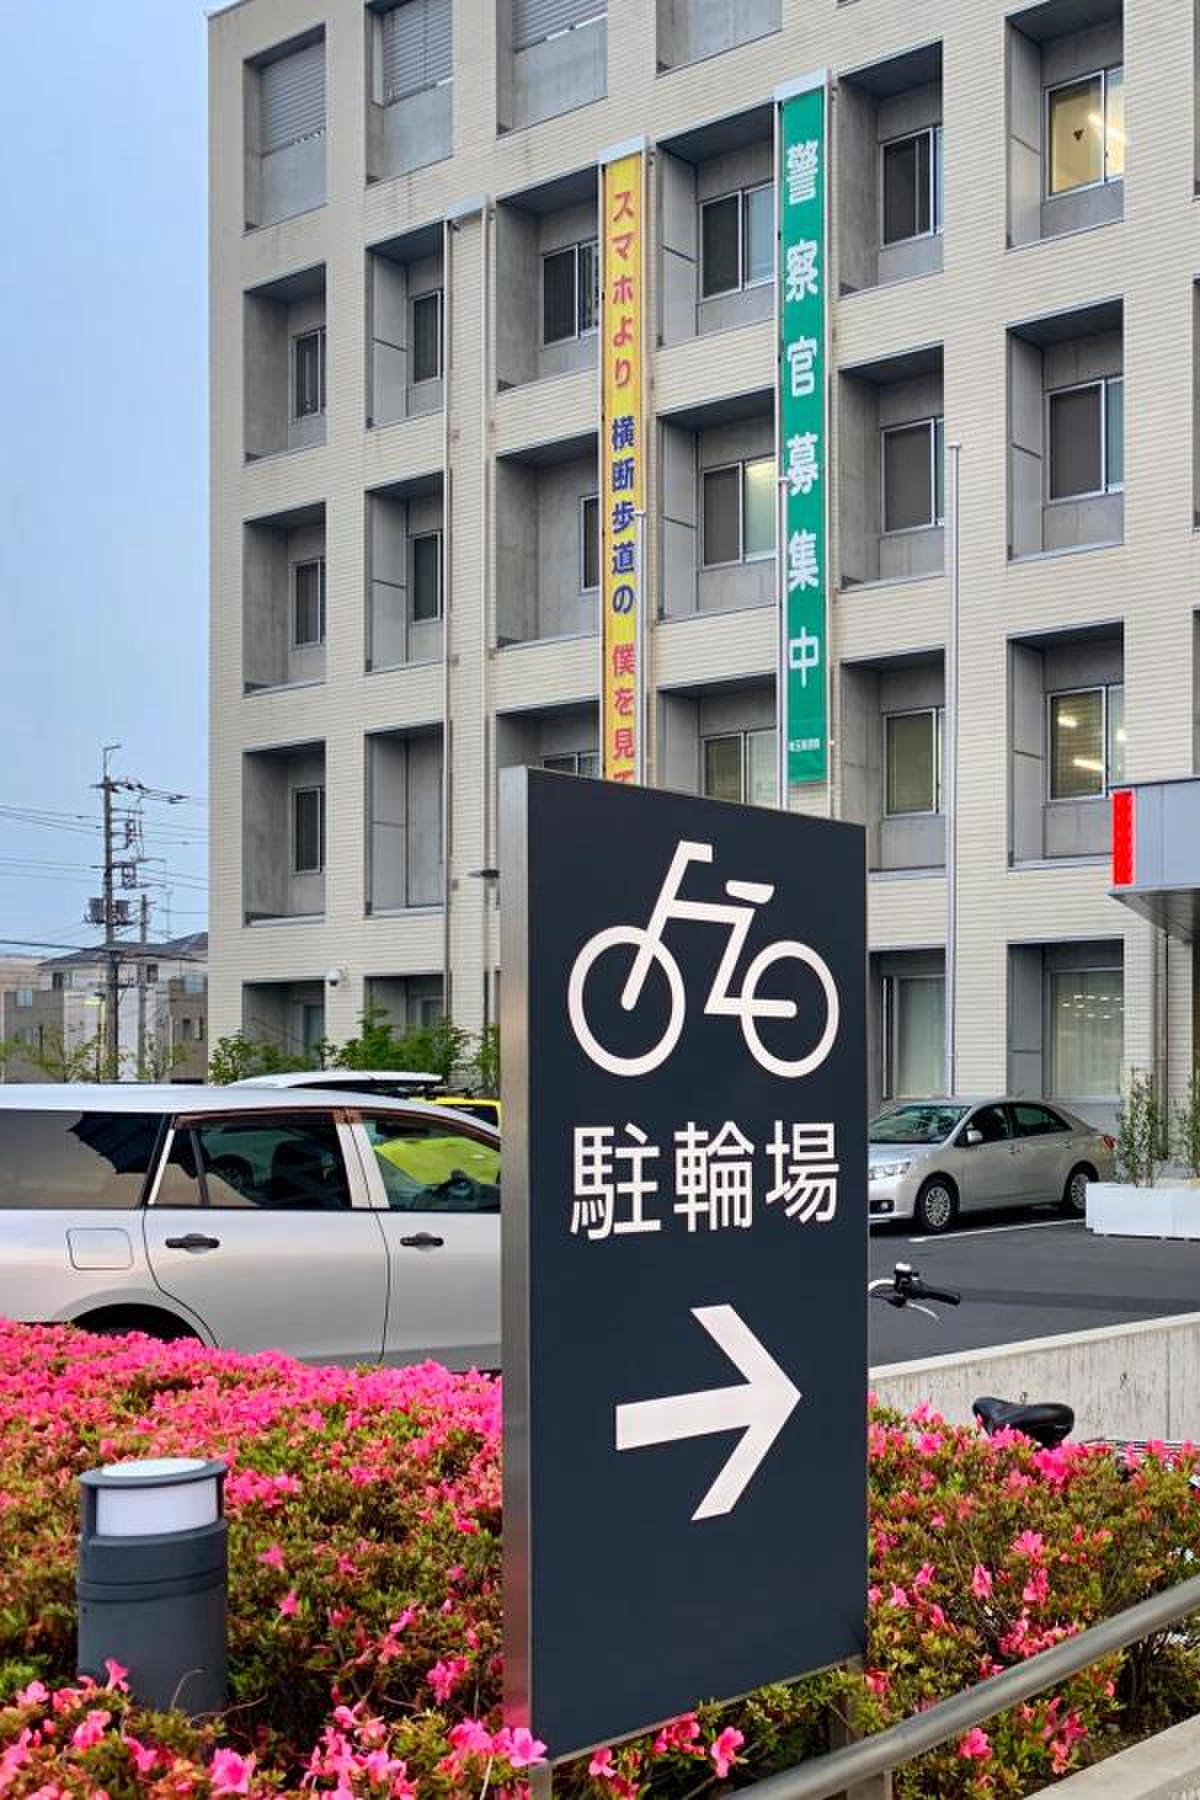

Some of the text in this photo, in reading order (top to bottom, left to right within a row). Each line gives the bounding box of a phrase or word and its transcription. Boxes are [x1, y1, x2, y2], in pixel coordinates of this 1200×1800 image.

[786, 139, 819, 688] 警察官募集中
[569, 1119, 840, 1241] 駐輪場
